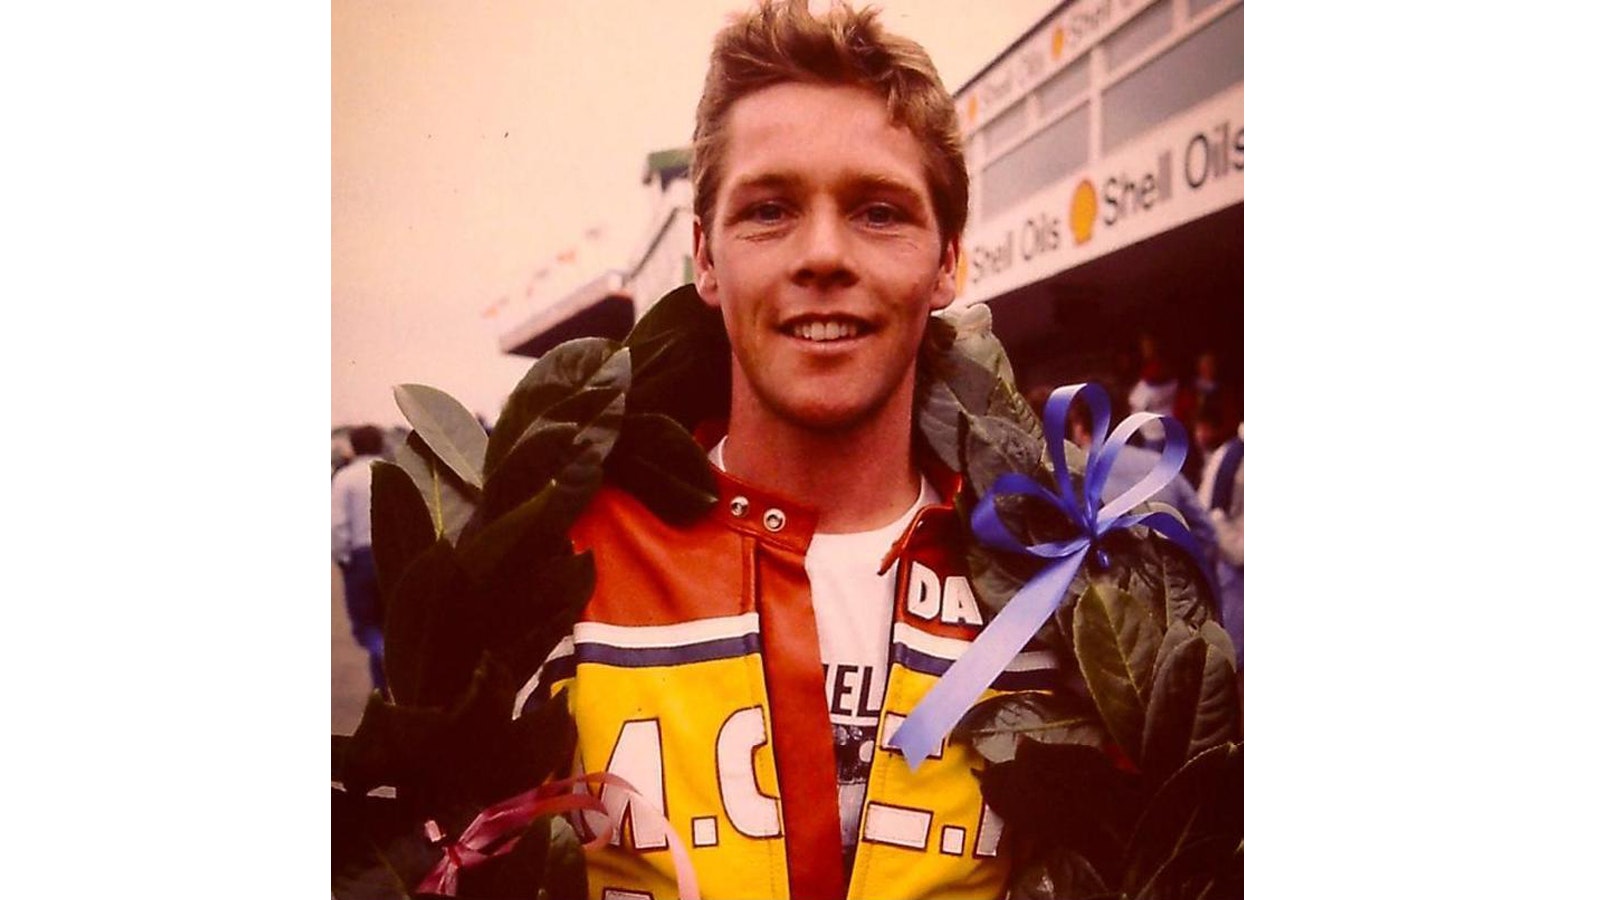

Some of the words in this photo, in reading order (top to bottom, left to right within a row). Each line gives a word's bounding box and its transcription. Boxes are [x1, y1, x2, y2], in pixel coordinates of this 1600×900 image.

[1103, 149, 1173, 226] Shell
[1185, 119, 1244, 189] Oils
[972, 229, 1013, 285] Shell
[1021, 213, 1062, 262] Oils
[823, 663, 882, 718] EL
